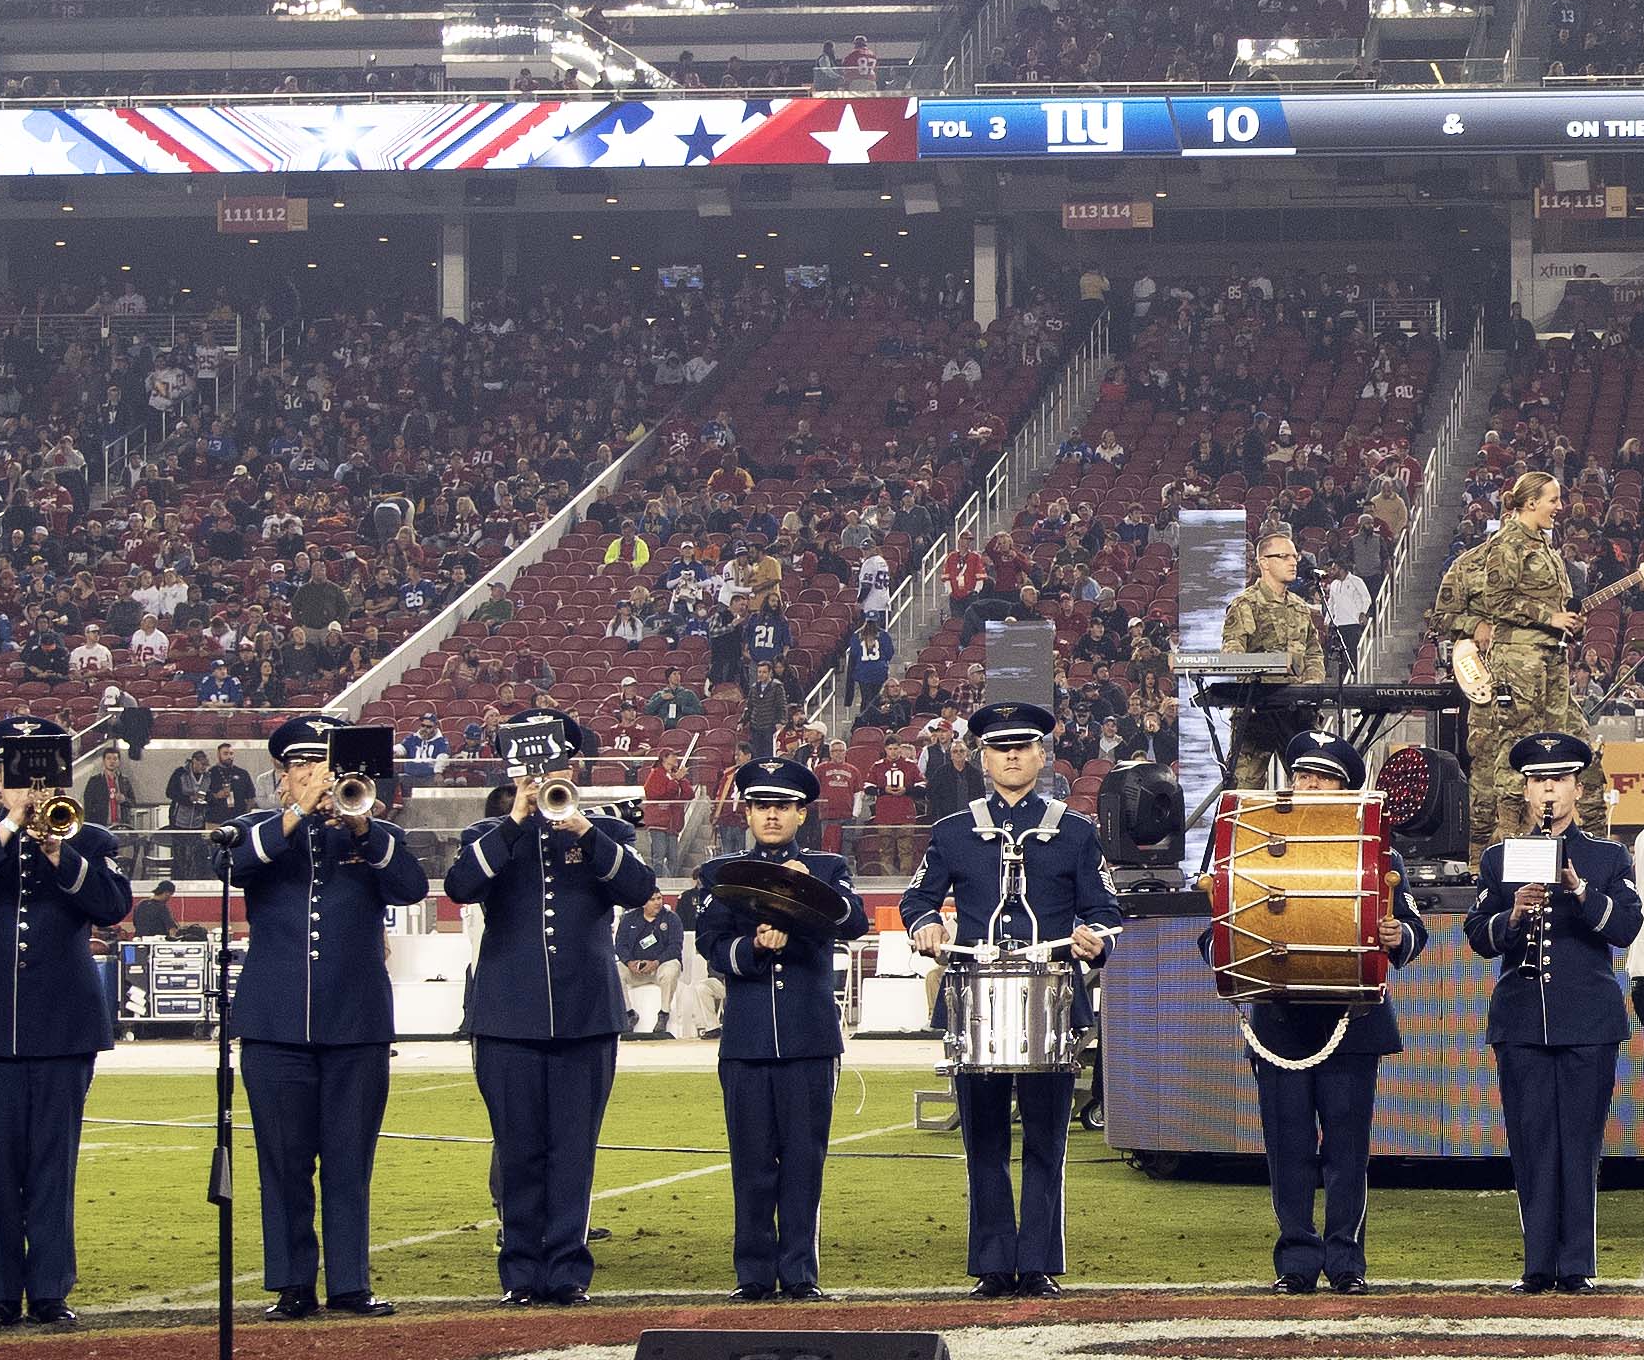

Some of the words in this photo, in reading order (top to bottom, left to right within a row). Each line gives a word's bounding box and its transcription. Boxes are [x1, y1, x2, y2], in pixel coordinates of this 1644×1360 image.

[1561, 9, 1574, 22] 13
[857, 57, 876, 74] 87
[1025, 71, 1038, 80] 10
[929, 121, 972, 138] TOL
[988, 117, 1007, 139] 3
[1207, 106, 1260, 143] 10
[1442, 114, 1465, 135] &
[1566, 120, 1600, 138] ON
[1540, 195, 1571, 209] 114
[1574, 195, 1605, 209] 115
[224, 208, 253, 222] 111
[257, 208, 286, 222] 112
[1068, 204, 1098, 218] 113
[1100, 204, 1130, 218] 114
[1228, 287, 1242, 300] 85
[405, 592, 423, 608] 26
[754, 626, 775, 648] 21
[859, 640, 881, 661] 13
[78, 657, 100, 671] 16
[1176, 655, 1207, 664] VIRUS
[1376, 688, 1439, 697] MONTAGE
[884, 770, 905, 789] 10
